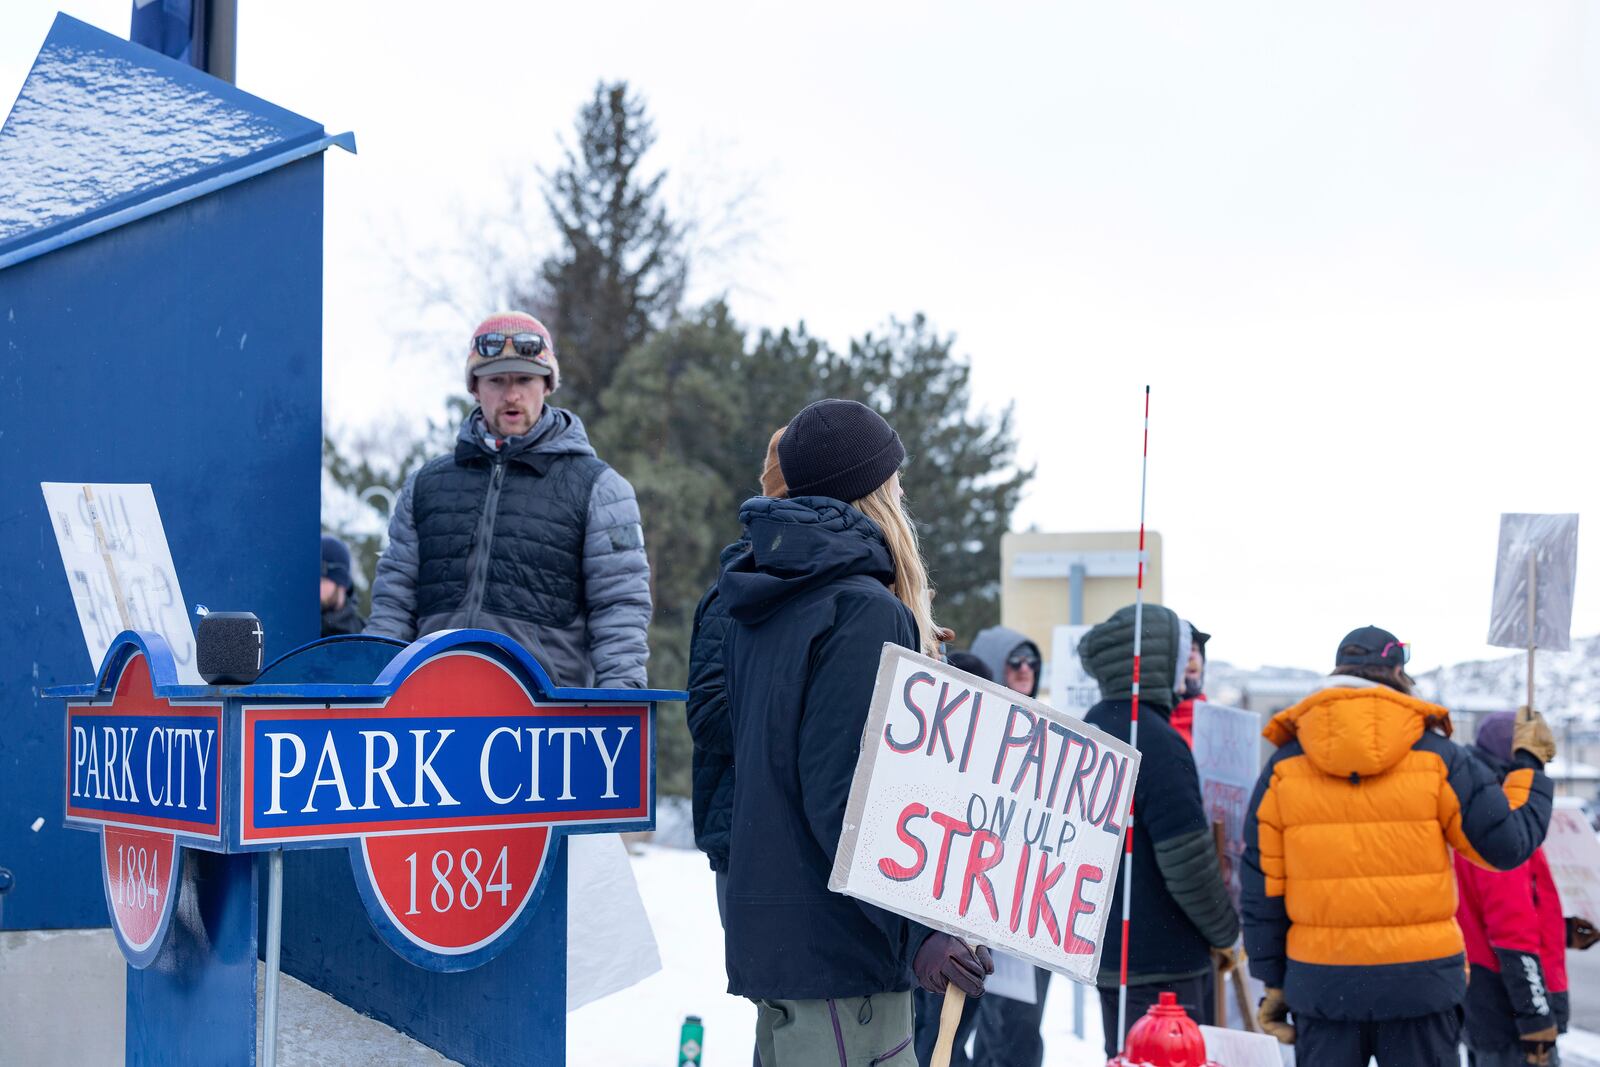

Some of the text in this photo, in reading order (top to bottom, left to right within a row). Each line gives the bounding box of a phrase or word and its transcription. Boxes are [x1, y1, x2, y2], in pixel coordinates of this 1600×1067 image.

[73, 725, 215, 811] PARK CITY
[263, 726, 633, 815] PARK CITY
[884, 671, 983, 773] SKI
[992, 703, 1129, 837] PATROL
[966, 793, 1076, 857] ON ULP
[118, 844, 159, 912] 1884
[404, 845, 513, 917] 1884
[878, 802, 1104, 955] STRIKE
